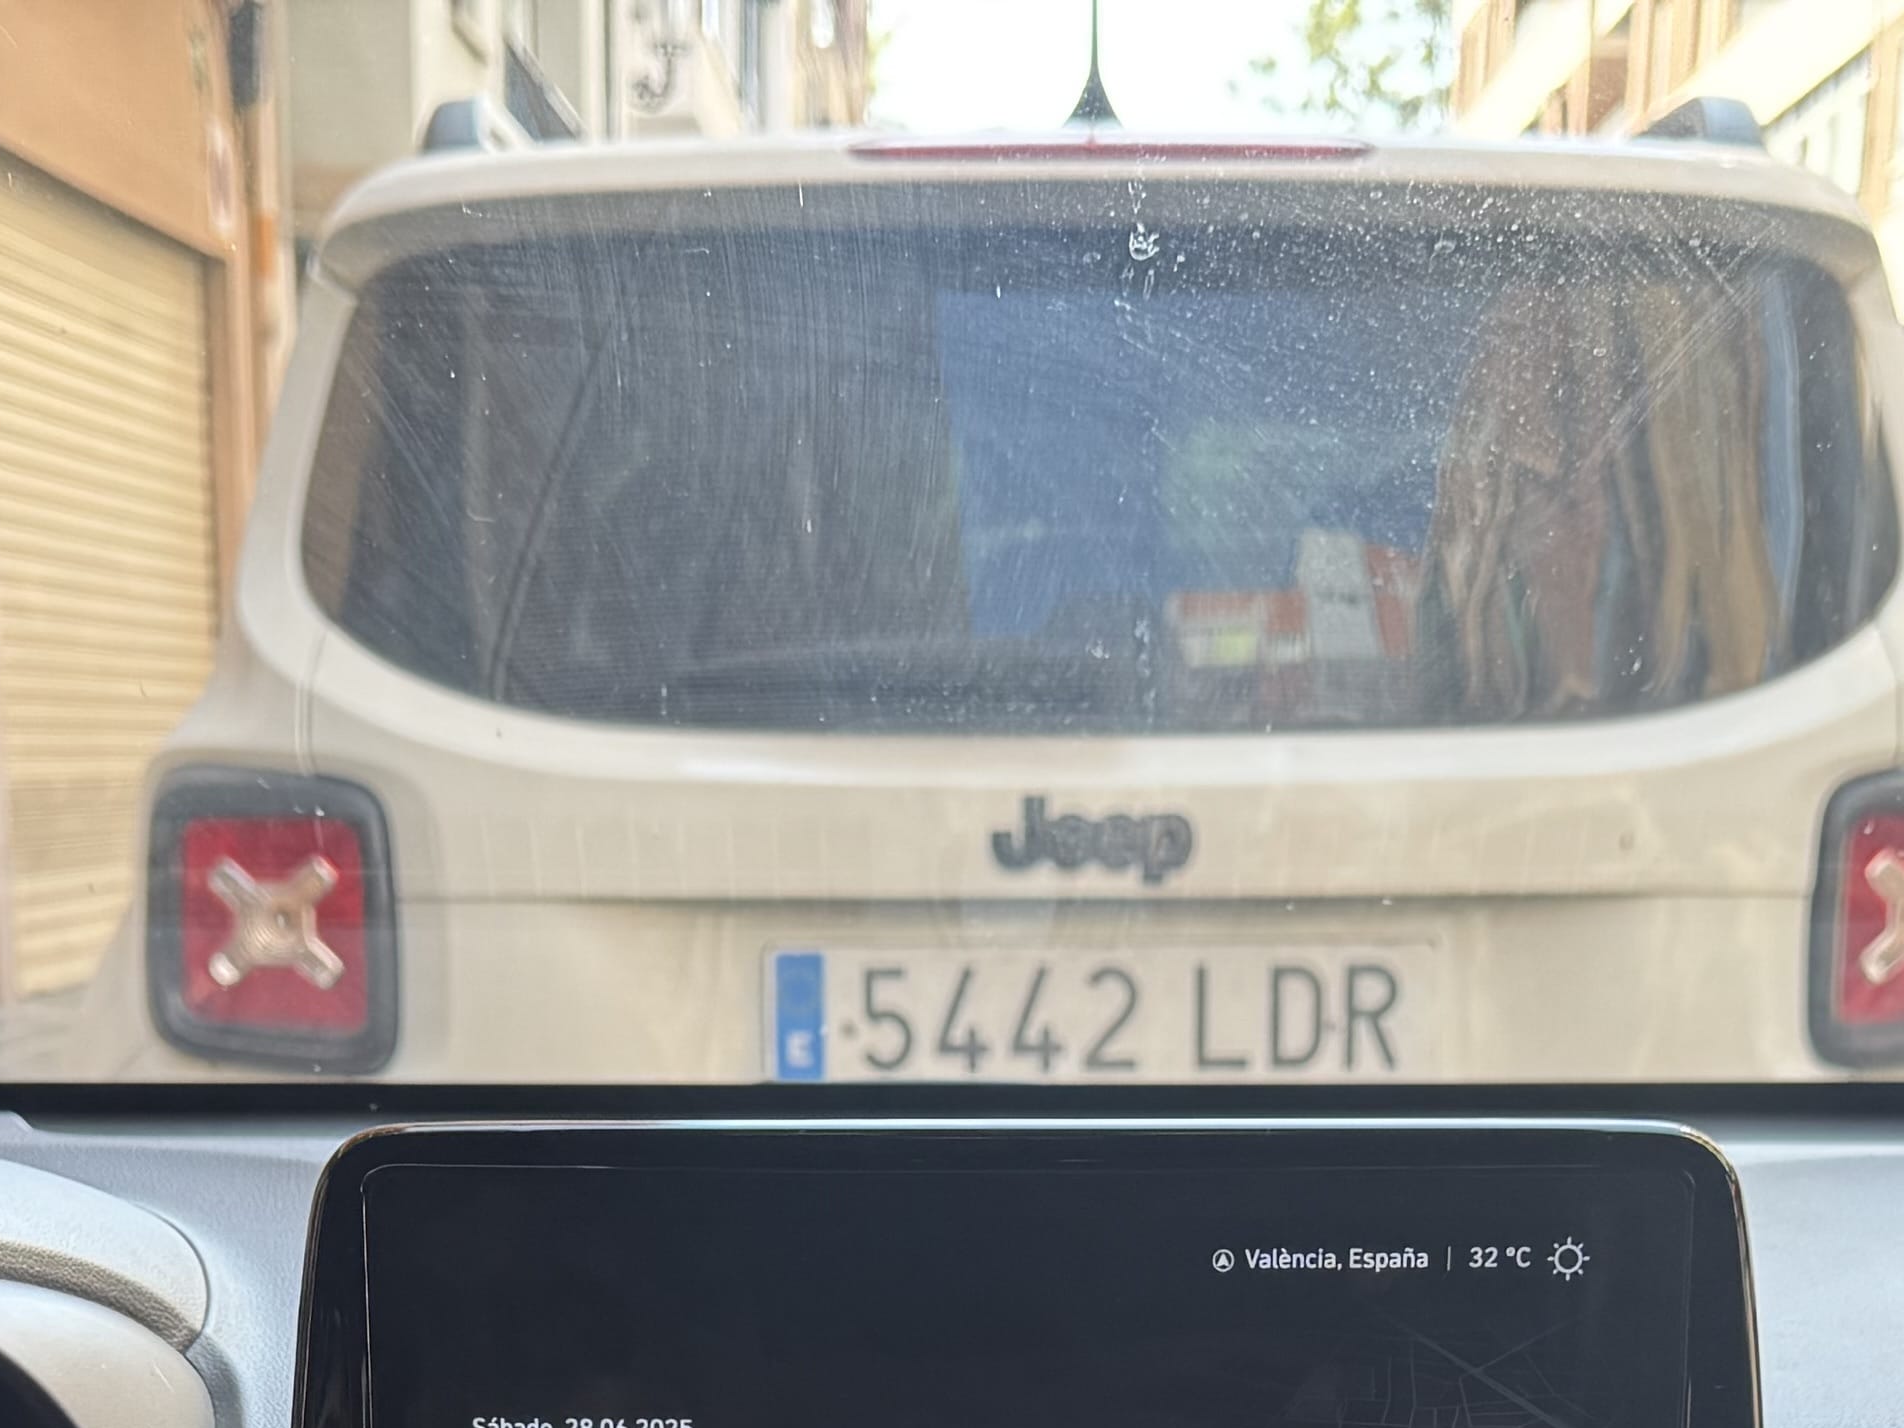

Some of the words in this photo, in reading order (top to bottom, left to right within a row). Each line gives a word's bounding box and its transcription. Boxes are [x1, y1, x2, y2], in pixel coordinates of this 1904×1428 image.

[991, 796, 1193, 884] Jeep
[861, 967, 1138, 1071] 5442
[1195, 967, 1399, 1071] LDR
[1245, 1247, 1343, 1271] València,
[1349, 1247, 1429, 1273] España
[1468, 1246, 1498, 1268] 32
